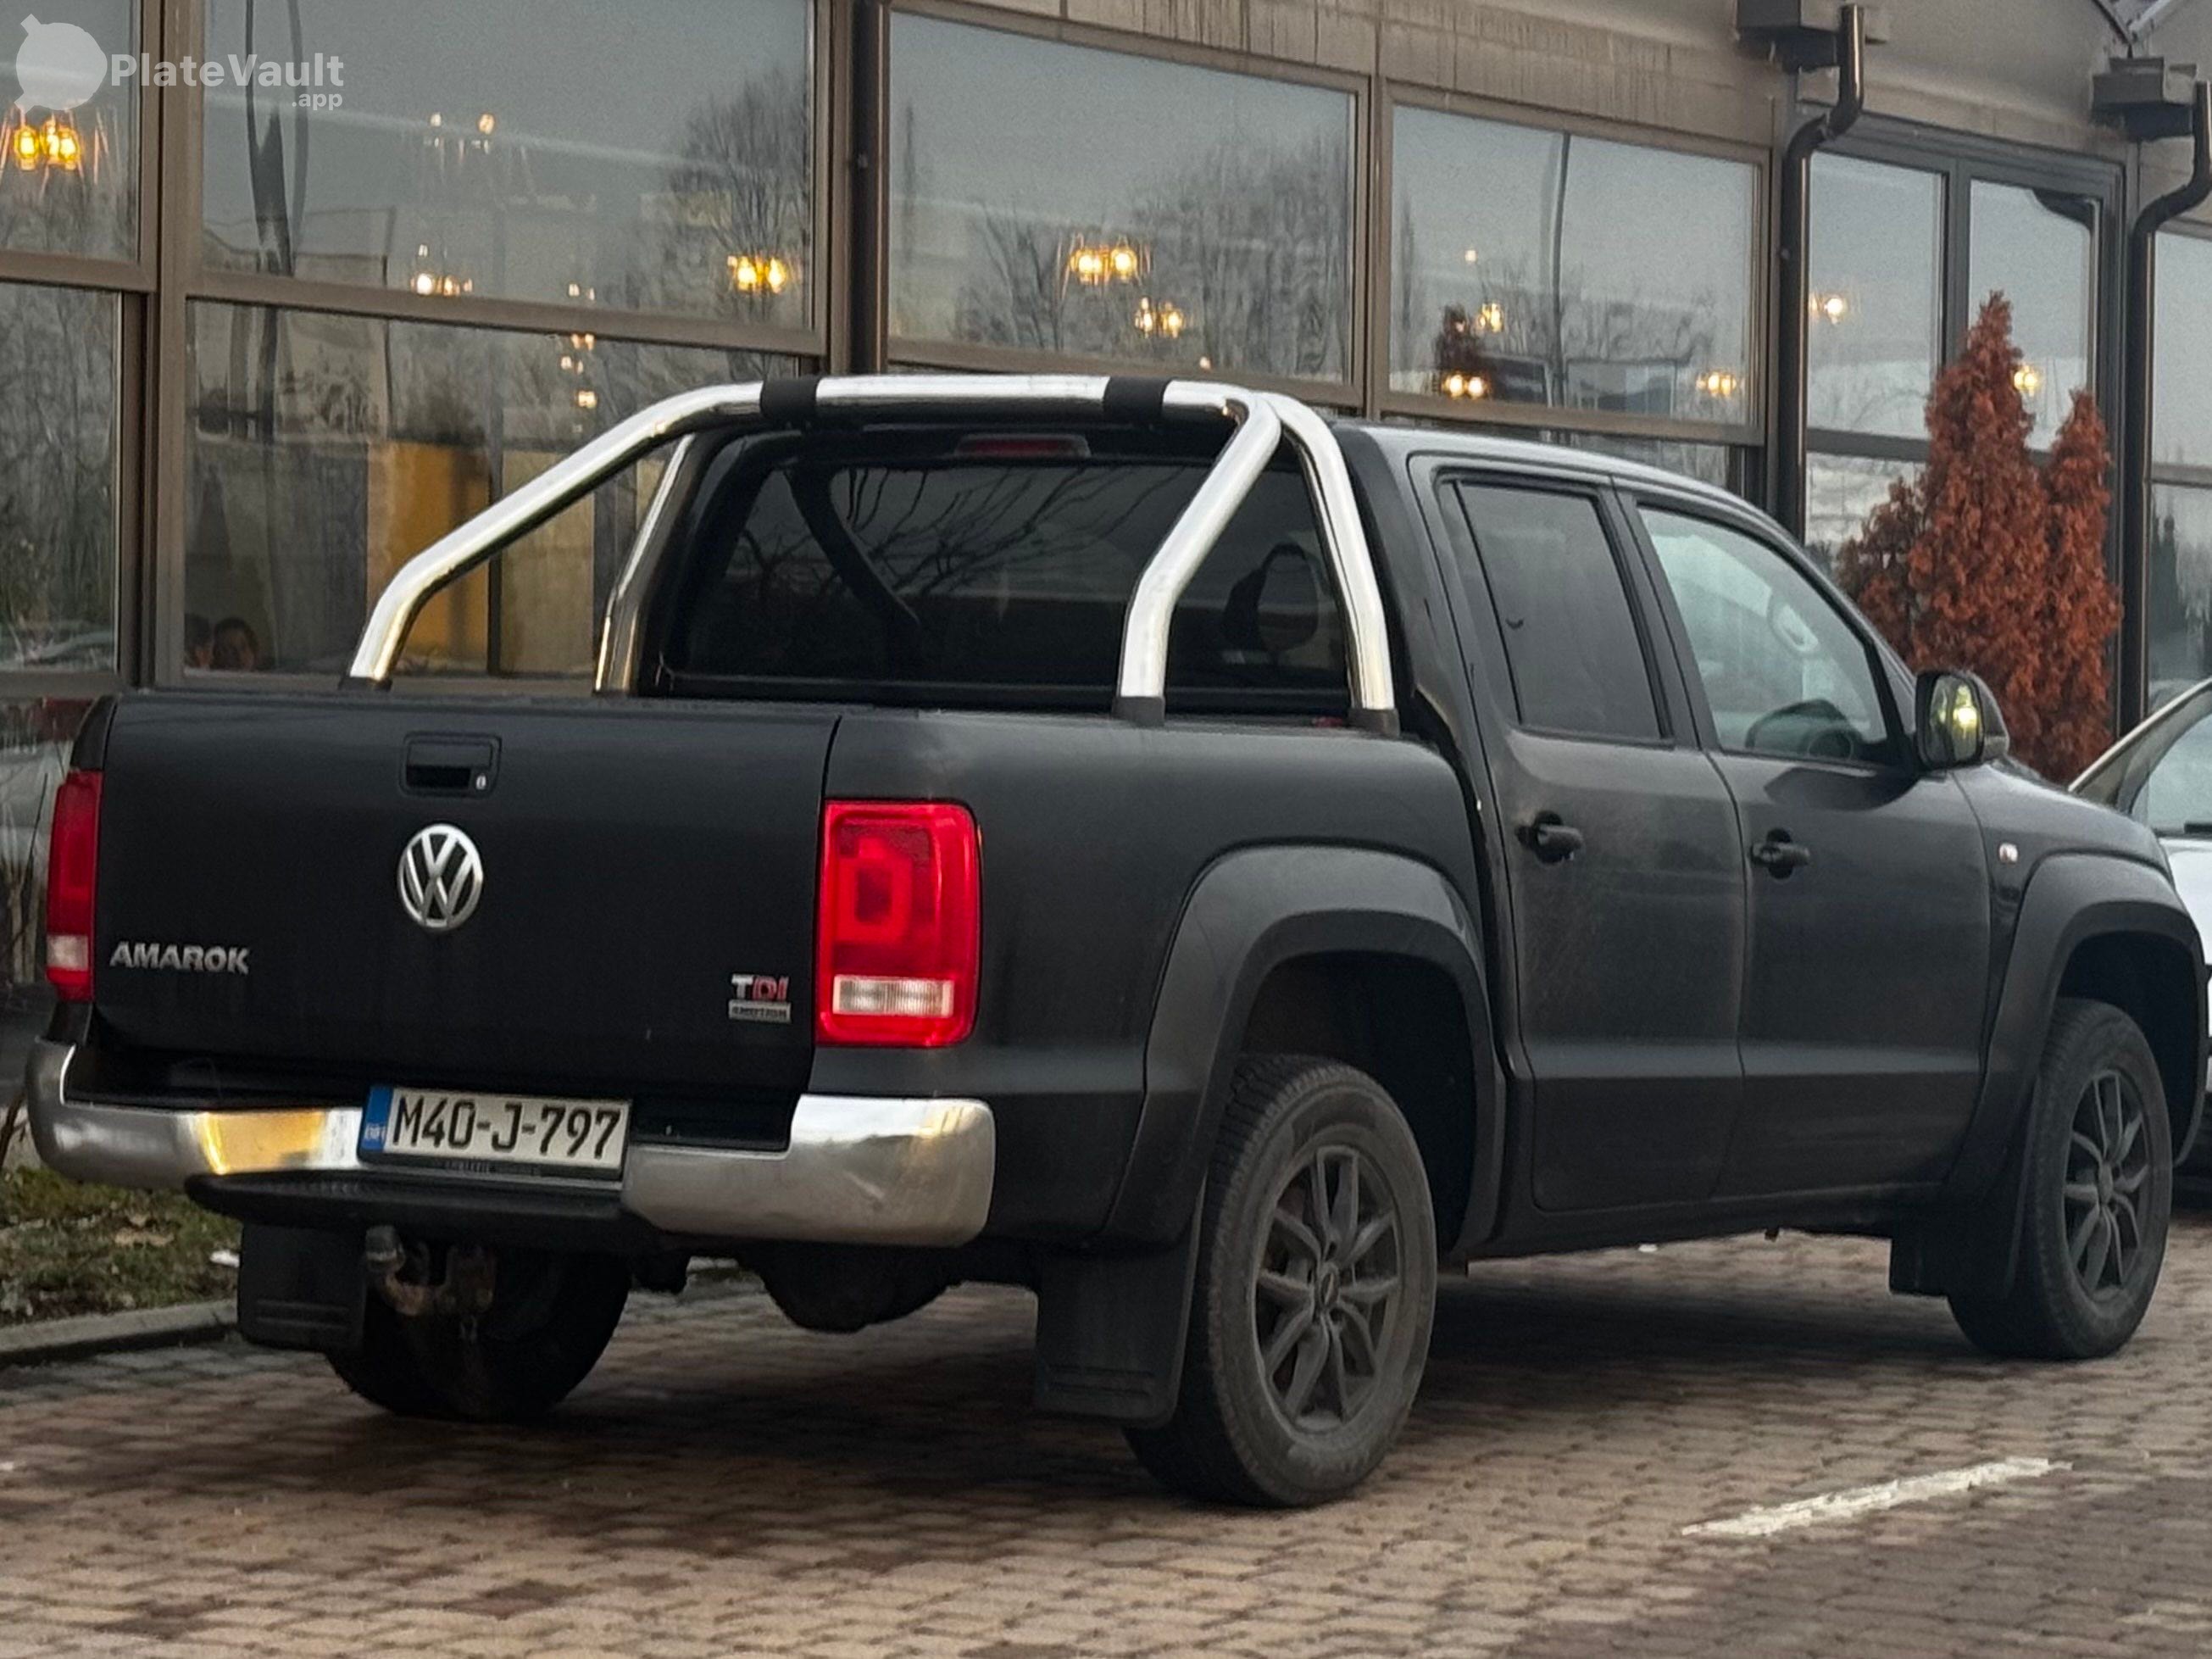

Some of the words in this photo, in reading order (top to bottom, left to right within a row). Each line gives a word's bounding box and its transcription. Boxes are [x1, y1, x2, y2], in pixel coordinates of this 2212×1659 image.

[109, 941, 250, 975] AMAROK
[731, 974, 790, 1000] TDI
[392, 1095, 621, 1160] M40-J-797
